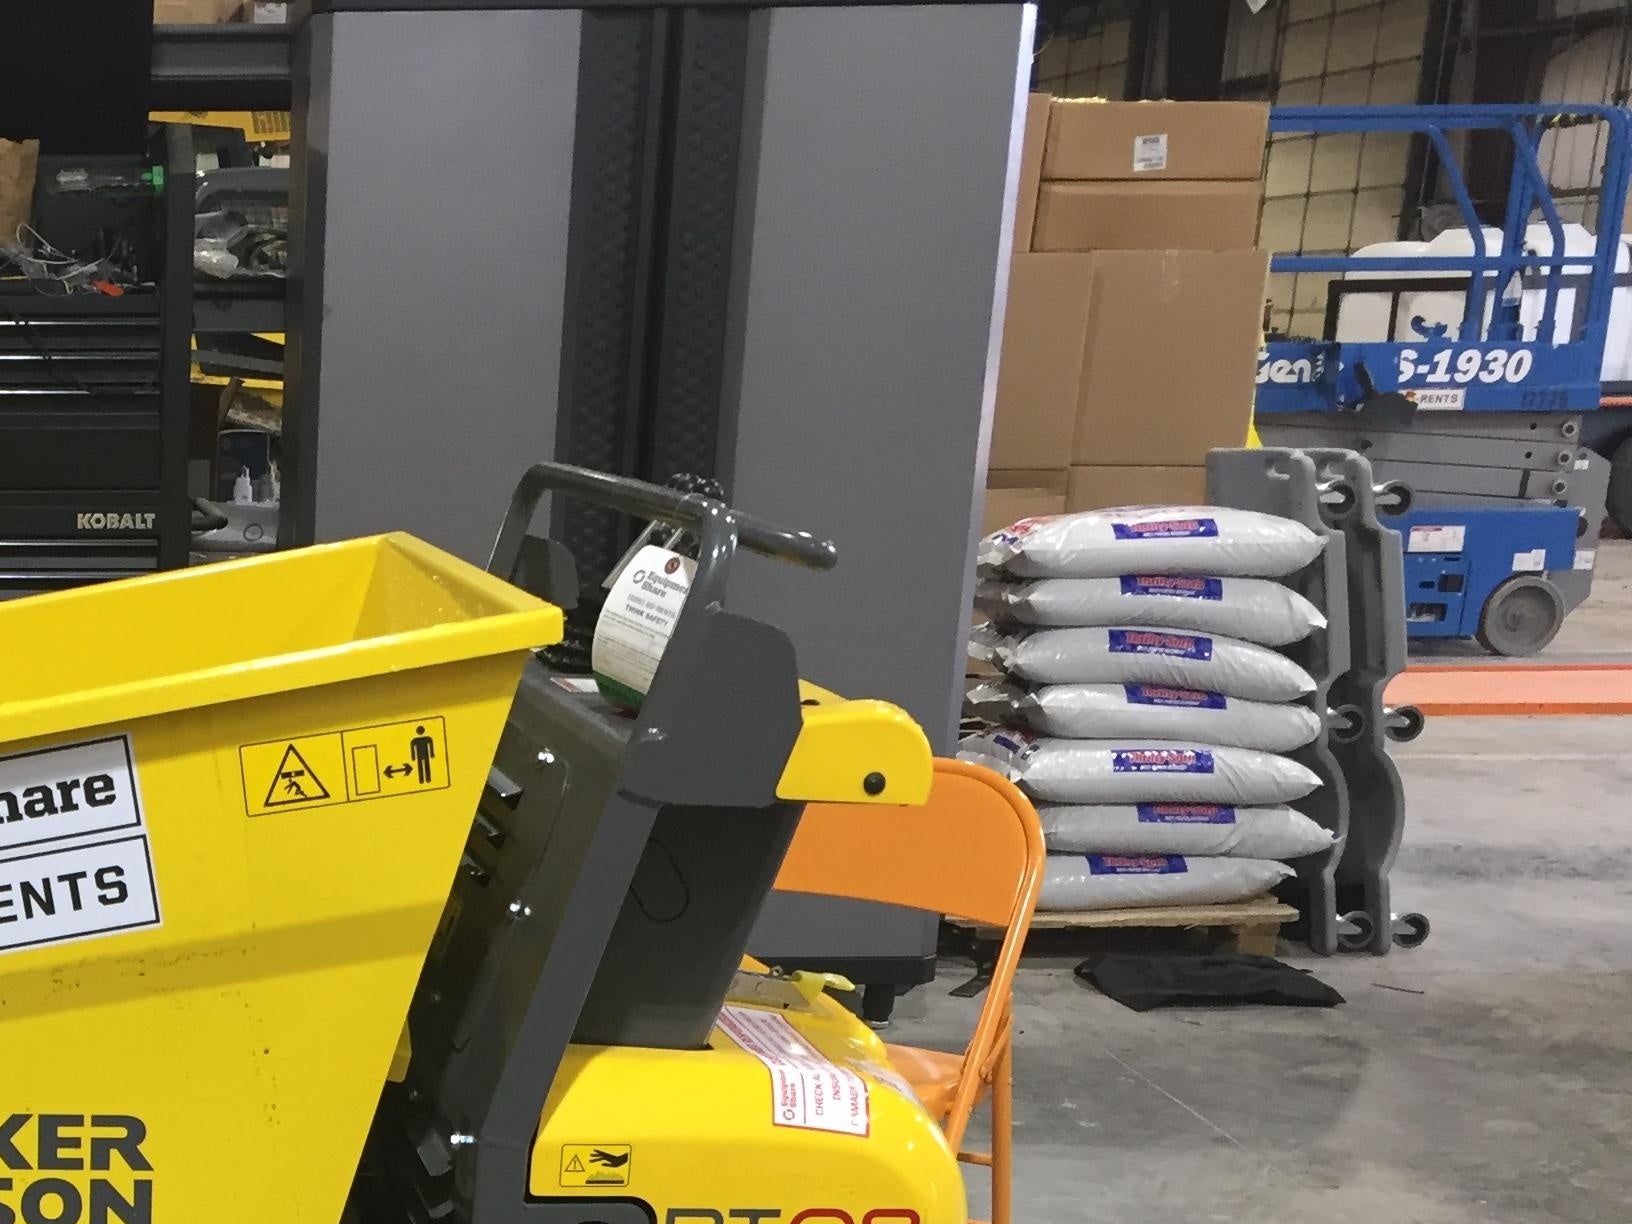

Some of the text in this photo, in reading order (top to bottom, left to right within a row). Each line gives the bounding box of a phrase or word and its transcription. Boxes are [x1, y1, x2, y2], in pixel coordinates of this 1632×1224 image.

[1396, 349, 1533, 384] S-1930
[77, 513, 156, 529] KOBALT
[814, 1082, 824, 1116] CHECK
